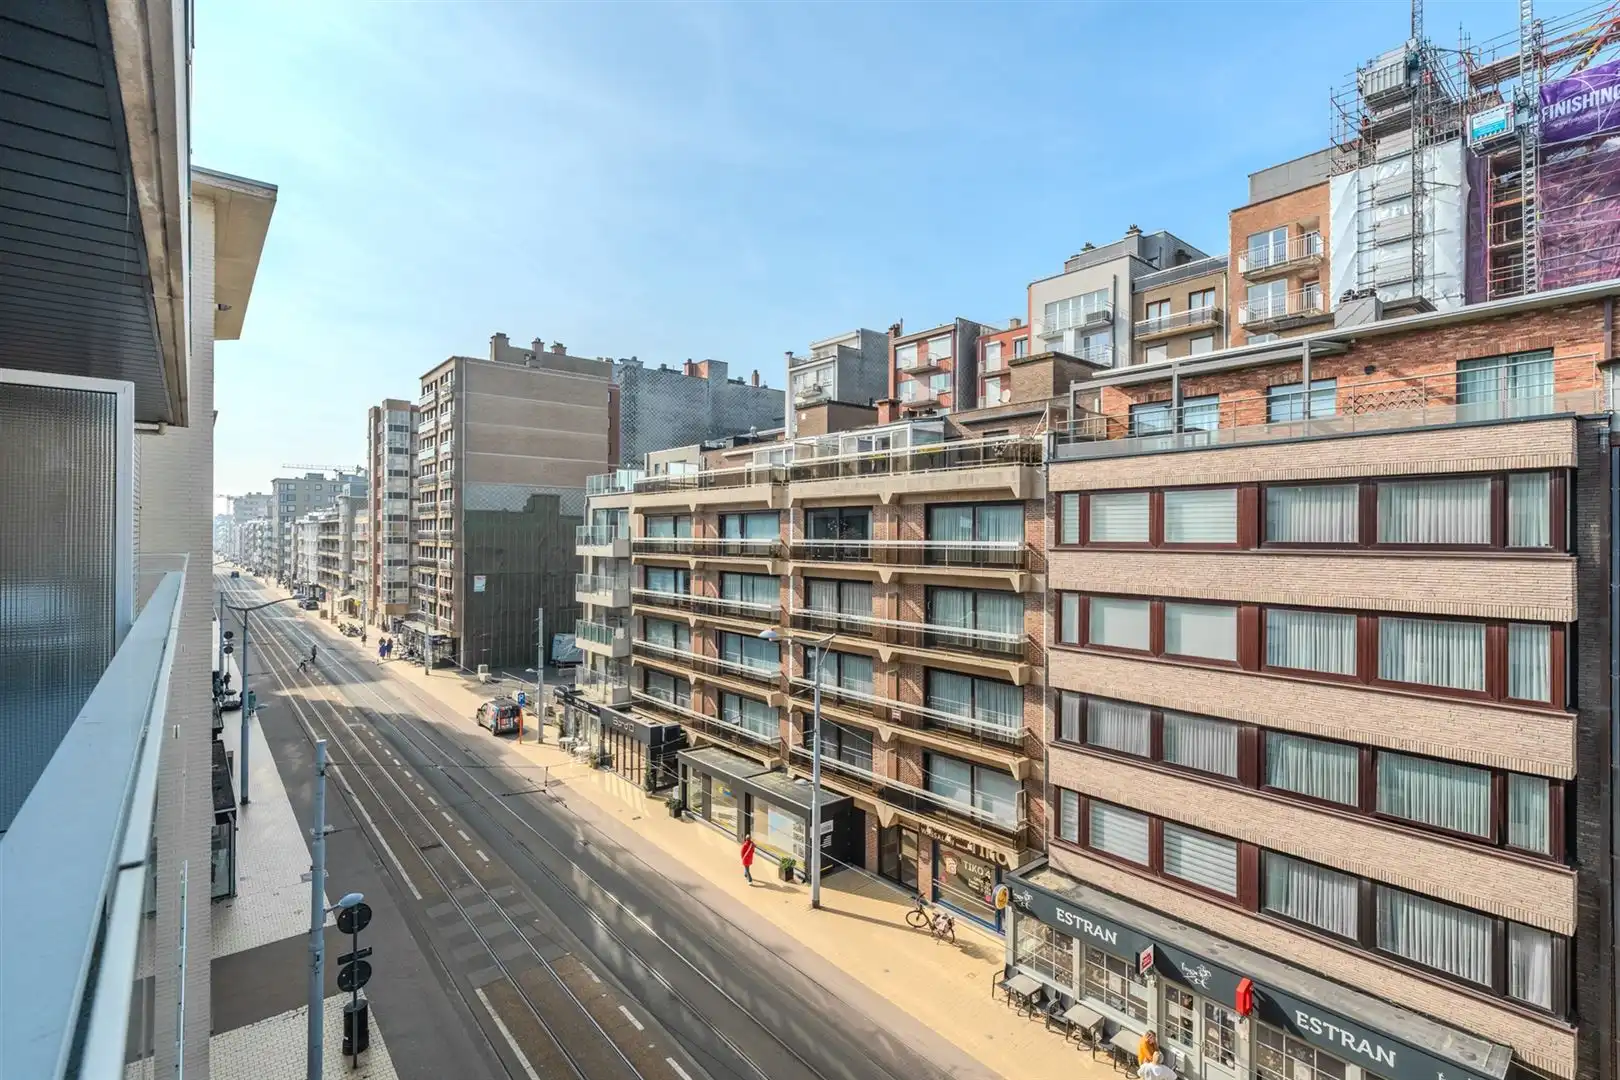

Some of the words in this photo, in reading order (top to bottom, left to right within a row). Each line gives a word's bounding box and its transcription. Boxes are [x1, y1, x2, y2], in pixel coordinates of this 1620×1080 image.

[962, 860, 984, 876] TIKO
[1056, 907, 1117, 945] ESTRAN
[1295, 1010, 1396, 1068] ESTRAN
